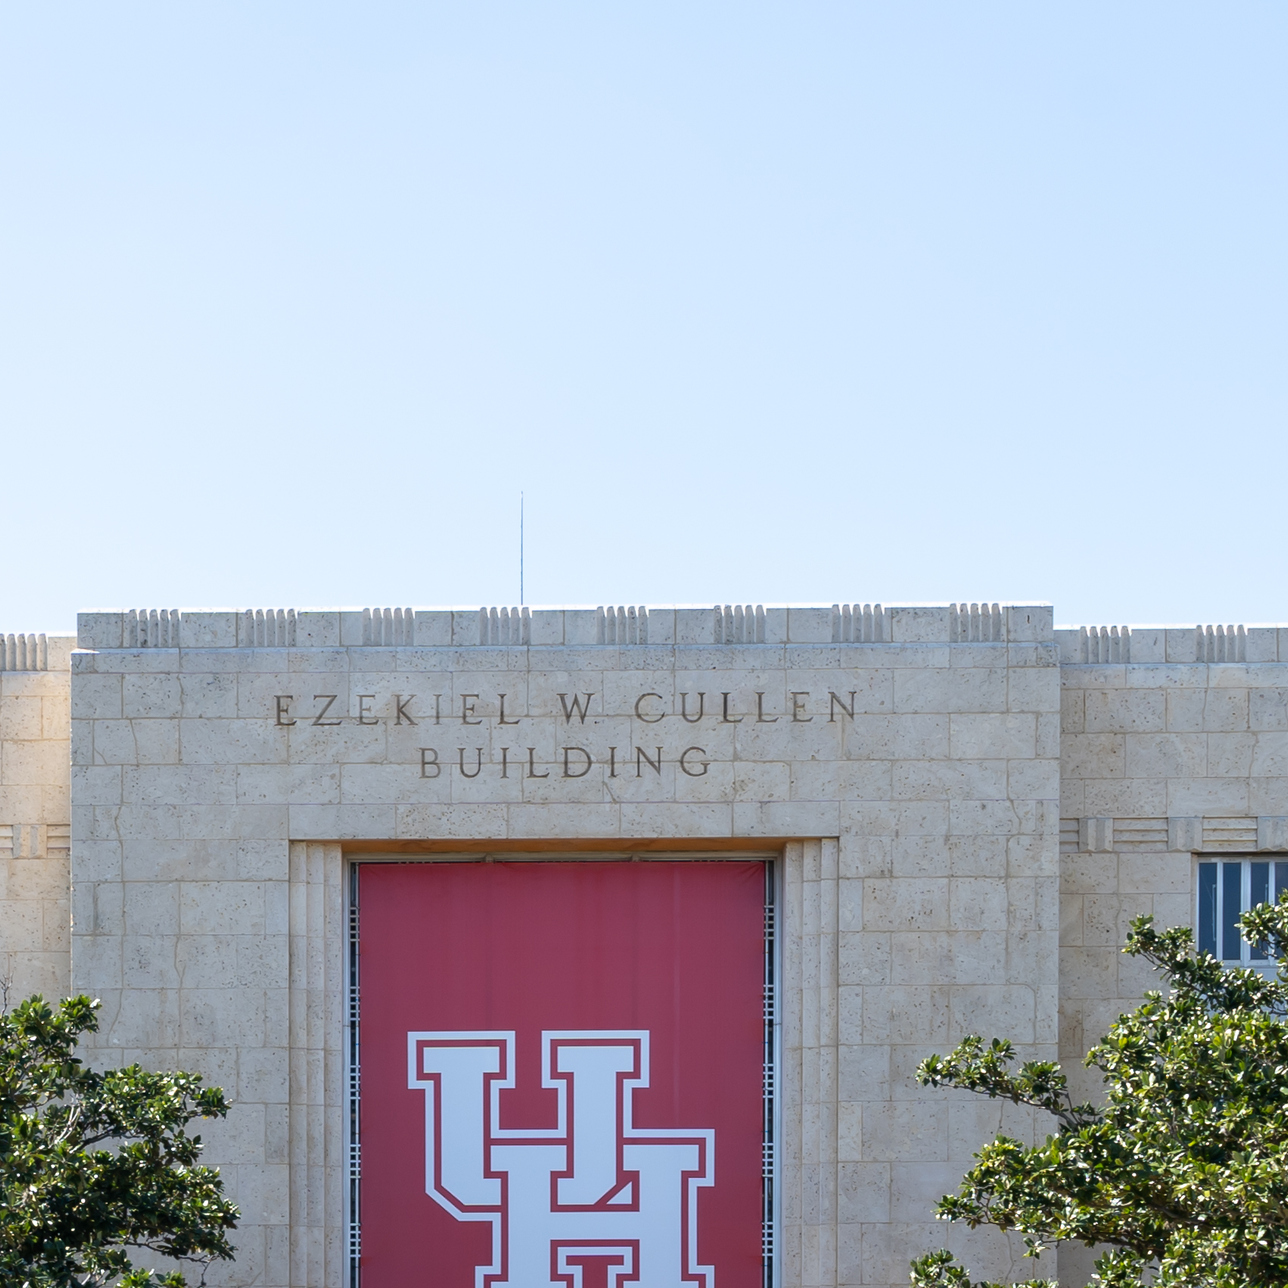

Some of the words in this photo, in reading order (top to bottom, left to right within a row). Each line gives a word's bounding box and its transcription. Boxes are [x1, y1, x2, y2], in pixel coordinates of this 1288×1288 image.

[274, 693, 521, 727] EZEKIEL
[634, 690, 858, 725] CULLEN
[420, 745, 712, 780] BUILDING
